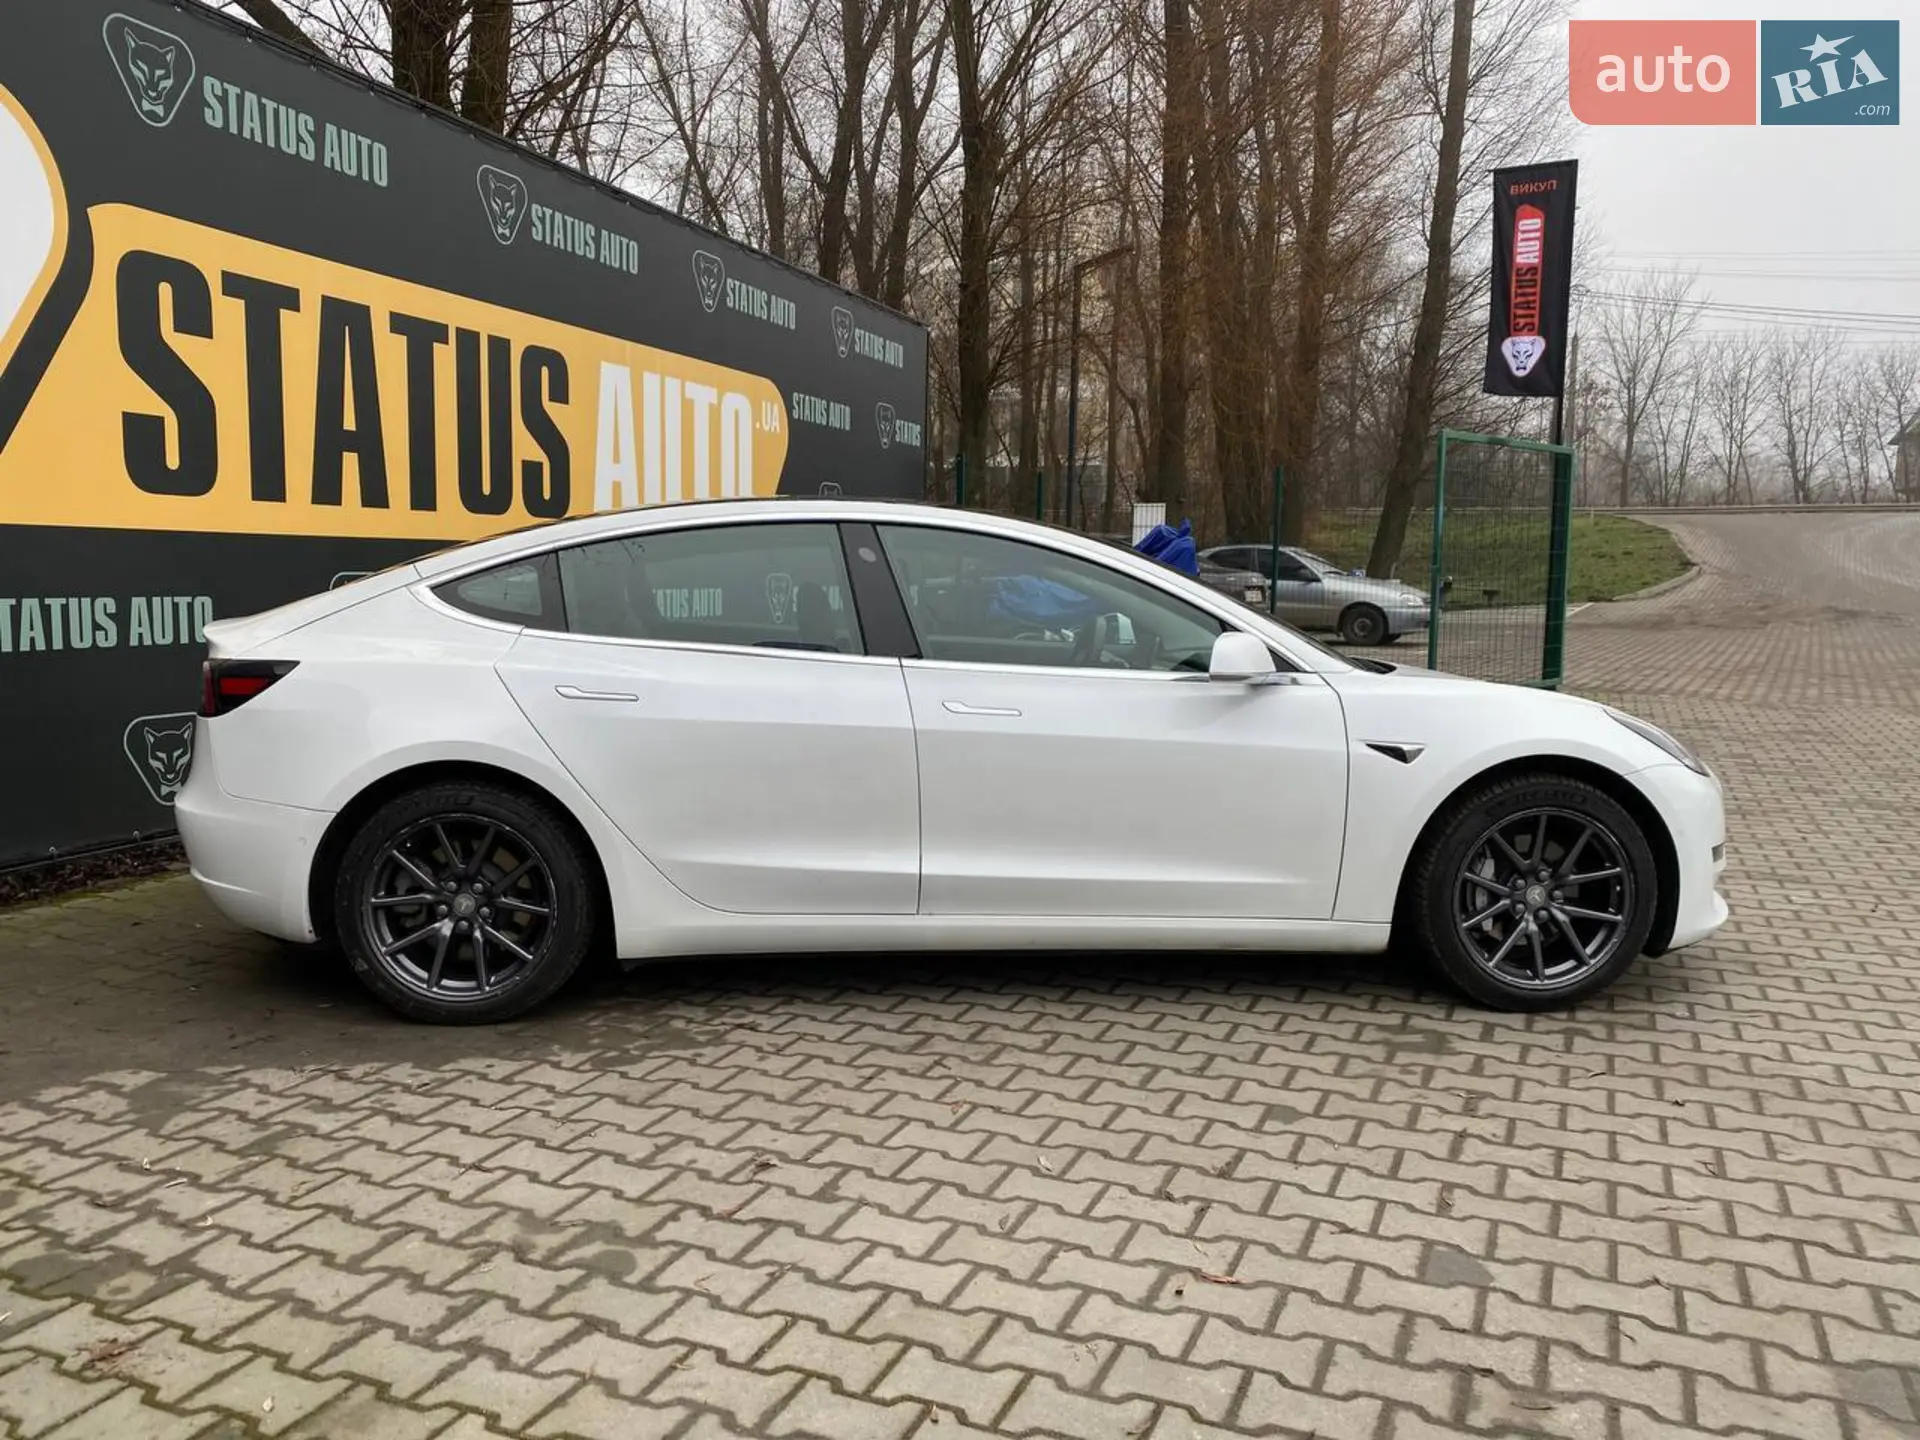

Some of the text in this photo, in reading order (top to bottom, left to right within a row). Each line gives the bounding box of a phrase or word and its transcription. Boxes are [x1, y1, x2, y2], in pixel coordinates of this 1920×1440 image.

[203, 75, 388, 188] STATUS AUTO
[1510, 179, 1558, 195] ВИКУП
[531, 203, 639, 275] STATUS AUTO
[1513, 218, 1542, 332] STATUS AUTO
[726, 278, 796, 330] STATUS AUTO
[854, 328, 904, 369] STATUS AUTO
[116, 249, 571, 520] STATUS
[593, 361, 753, 513] AUTO
[792, 391, 851, 431] STATUS AUTO
[895, 419, 921, 447] STATUS
[0, 596, 214, 652] TATUS AUTO
[652, 588, 723, 618] ATUS AUTO
